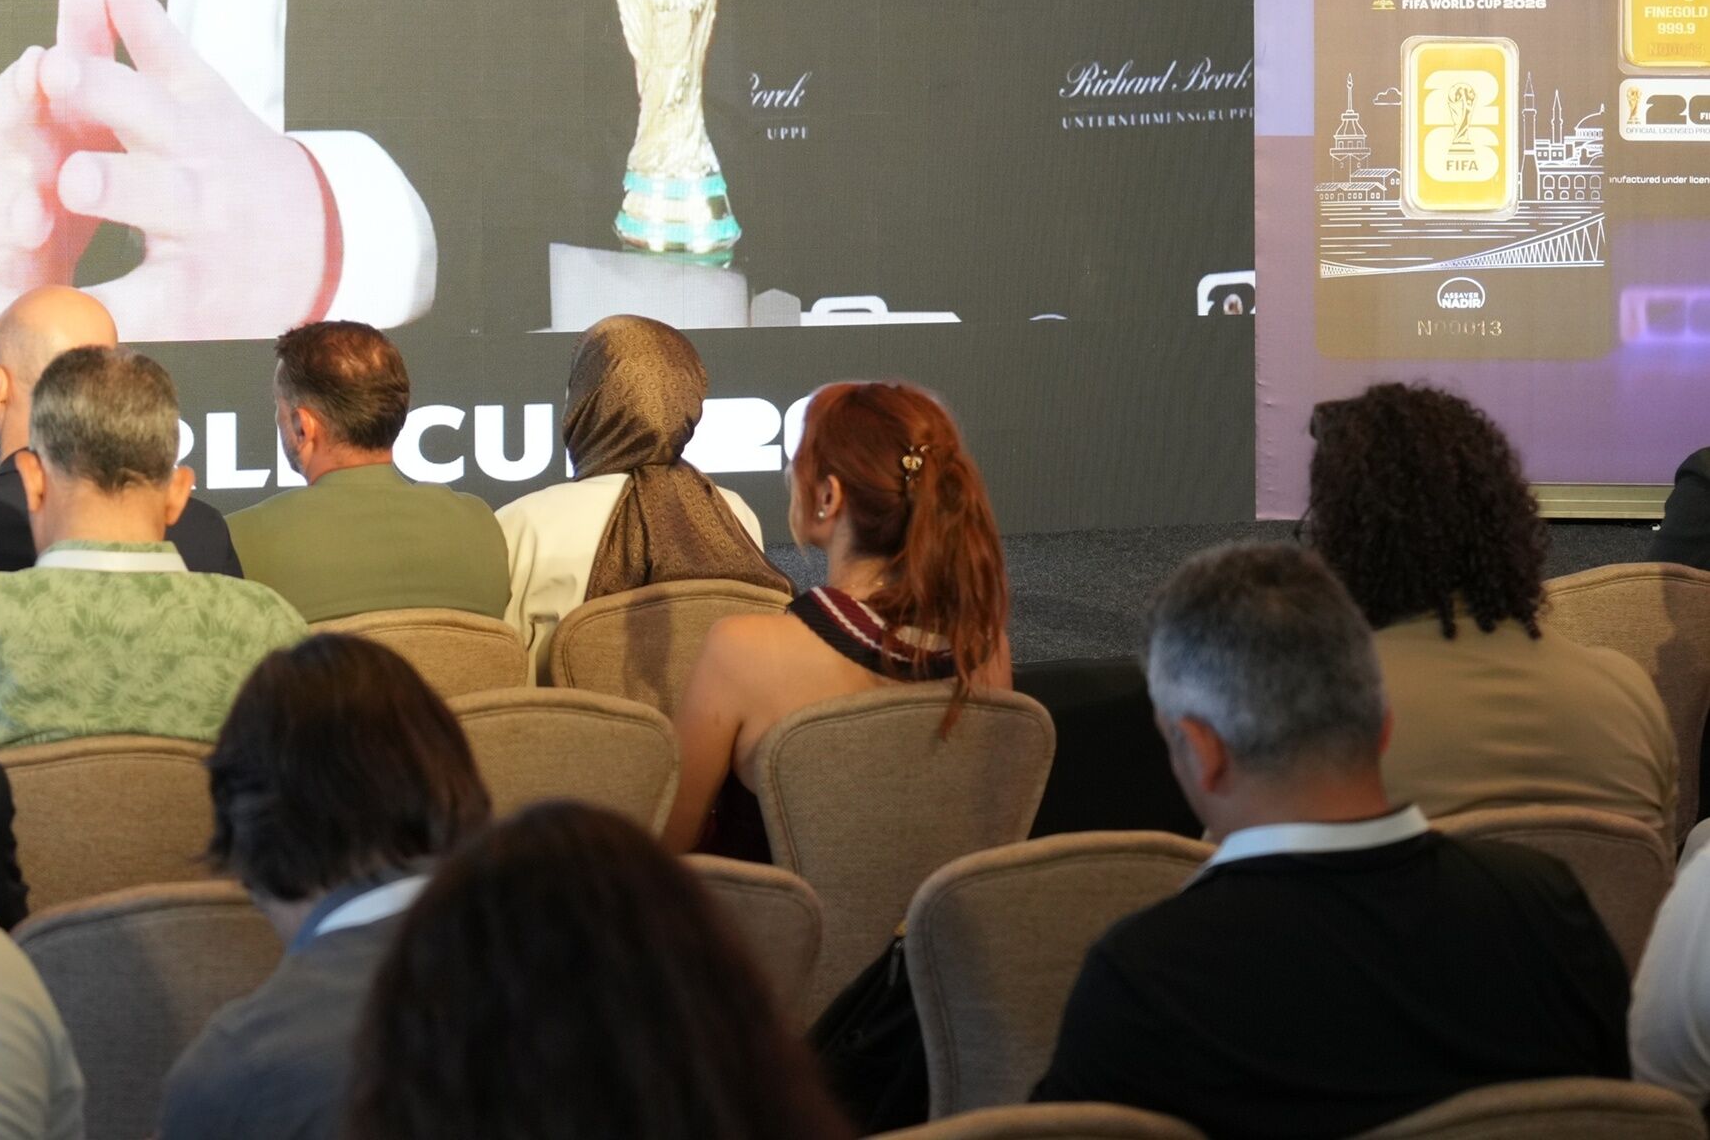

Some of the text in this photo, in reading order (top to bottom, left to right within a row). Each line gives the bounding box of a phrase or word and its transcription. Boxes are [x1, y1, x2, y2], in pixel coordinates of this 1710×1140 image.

[1402, 0, 1547, 9] FIFA WORLD CUP 2026
[1644, 6, 1708, 18] FINEGOLD
[1657, 22, 1696, 35] 999.9
[1059, 60, 1177, 98] Richard
[1446, 160, 1479, 172] FIFA
[1662, 175, 1687, 184] under
